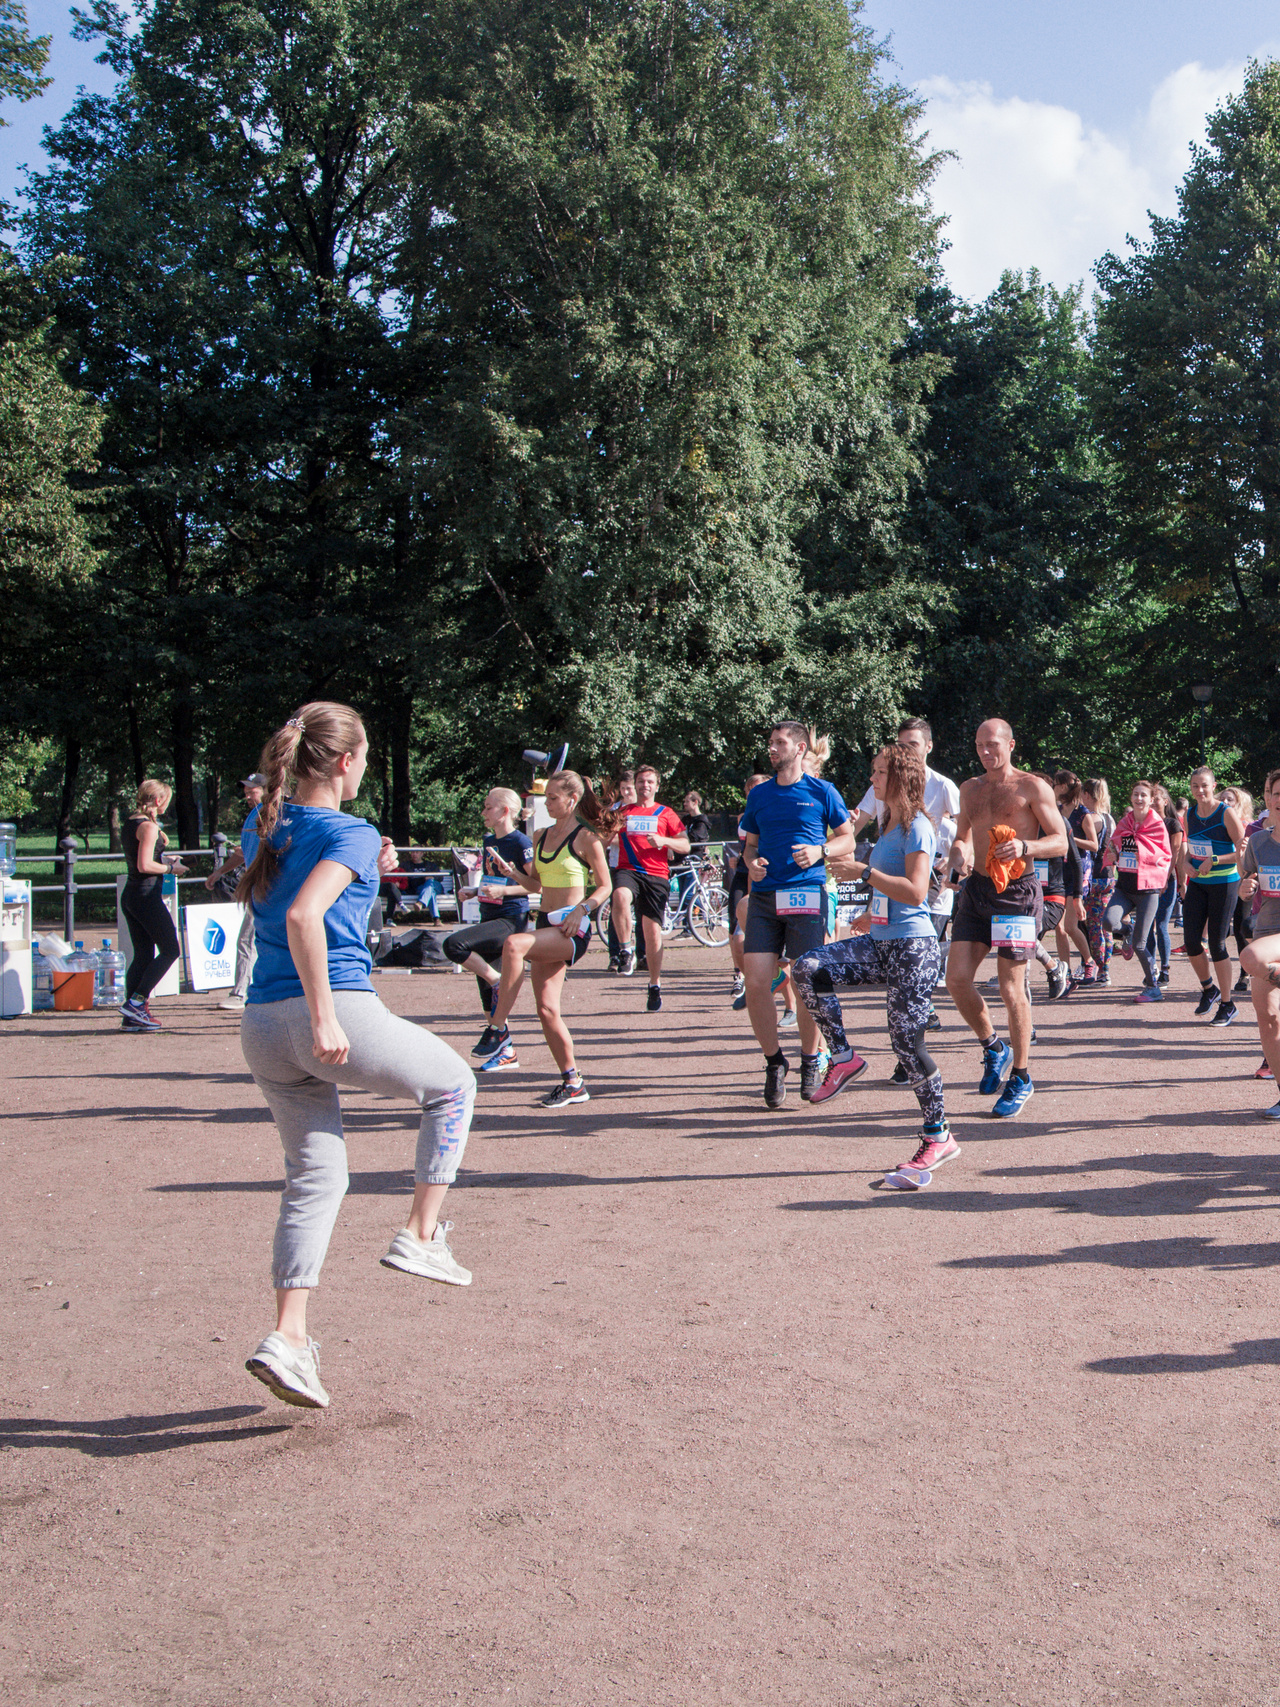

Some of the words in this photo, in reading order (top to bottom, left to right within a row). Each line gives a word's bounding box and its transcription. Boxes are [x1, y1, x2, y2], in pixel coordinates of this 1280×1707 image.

[634, 821, 650, 831] 261
[1125, 859, 1137, 868] 171
[789, 893, 807, 907] 53
[1005, 925, 1022, 939] 25
[207, 928, 220, 951] 7
[204, 960, 231, 971] СЕМЬ
